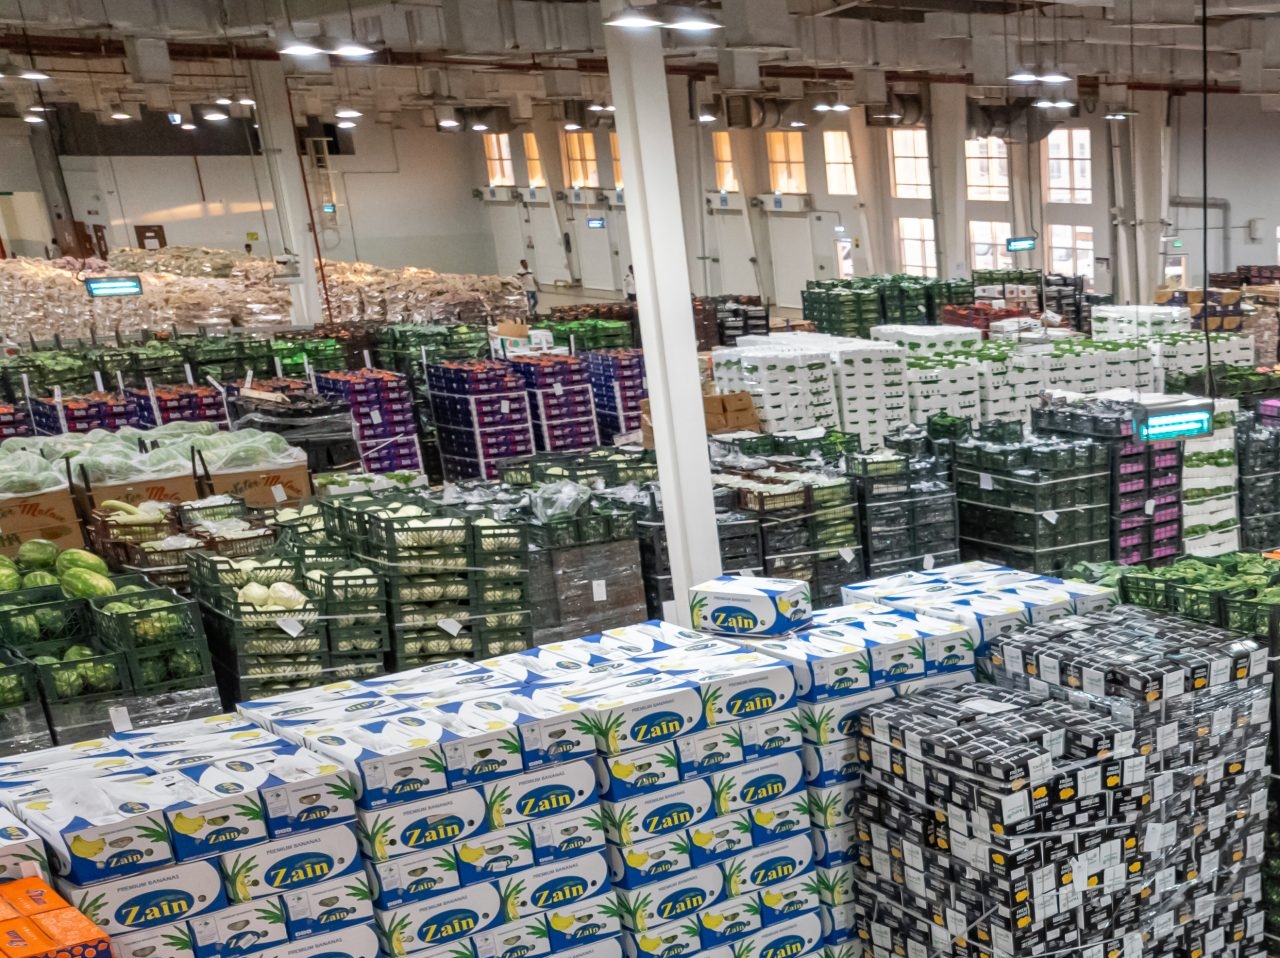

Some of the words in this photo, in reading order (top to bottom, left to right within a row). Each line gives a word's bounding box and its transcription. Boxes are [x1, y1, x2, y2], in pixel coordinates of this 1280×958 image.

[715, 613, 754, 628] Zain
[942, 655, 961, 666] Zain
[889, 664, 908, 675] Zain
[833, 679, 853, 690] Zain
[731, 696, 773, 715] Zain
[634, 719, 681, 742] Zain
[549, 741, 575, 755] Zain
[763, 739, 784, 750] Zain
[703, 755, 724, 767] Zain
[473, 762, 501, 776] Zain
[394, 780, 422, 795] Zain
[744, 782, 783, 802] Zain
[521, 792, 571, 815] Zain
[300, 807, 330, 821] Zain
[647, 810, 691, 833] Zain
[774, 821, 795, 833] Zain
[208, 830, 239, 844] Zain
[406, 822, 460, 847] Zain
[560, 838, 586, 852] Zain
[110, 853, 141, 867] Zain
[271, 859, 331, 888] Zain
[648, 863, 671, 875] Zain
[754, 863, 793, 885] Zain
[408, 879, 435, 893] Zain
[535, 884, 584, 907] Zain
[121, 898, 189, 925] Zain
[661, 894, 703, 918] Zain
[782, 901, 803, 913] Zain
[320, 911, 347, 923] Zain
[422, 917, 474, 942] Zain
[573, 924, 601, 939] Zain
[724, 923, 746, 936] Zain
[662, 946, 684, 958] Zain
